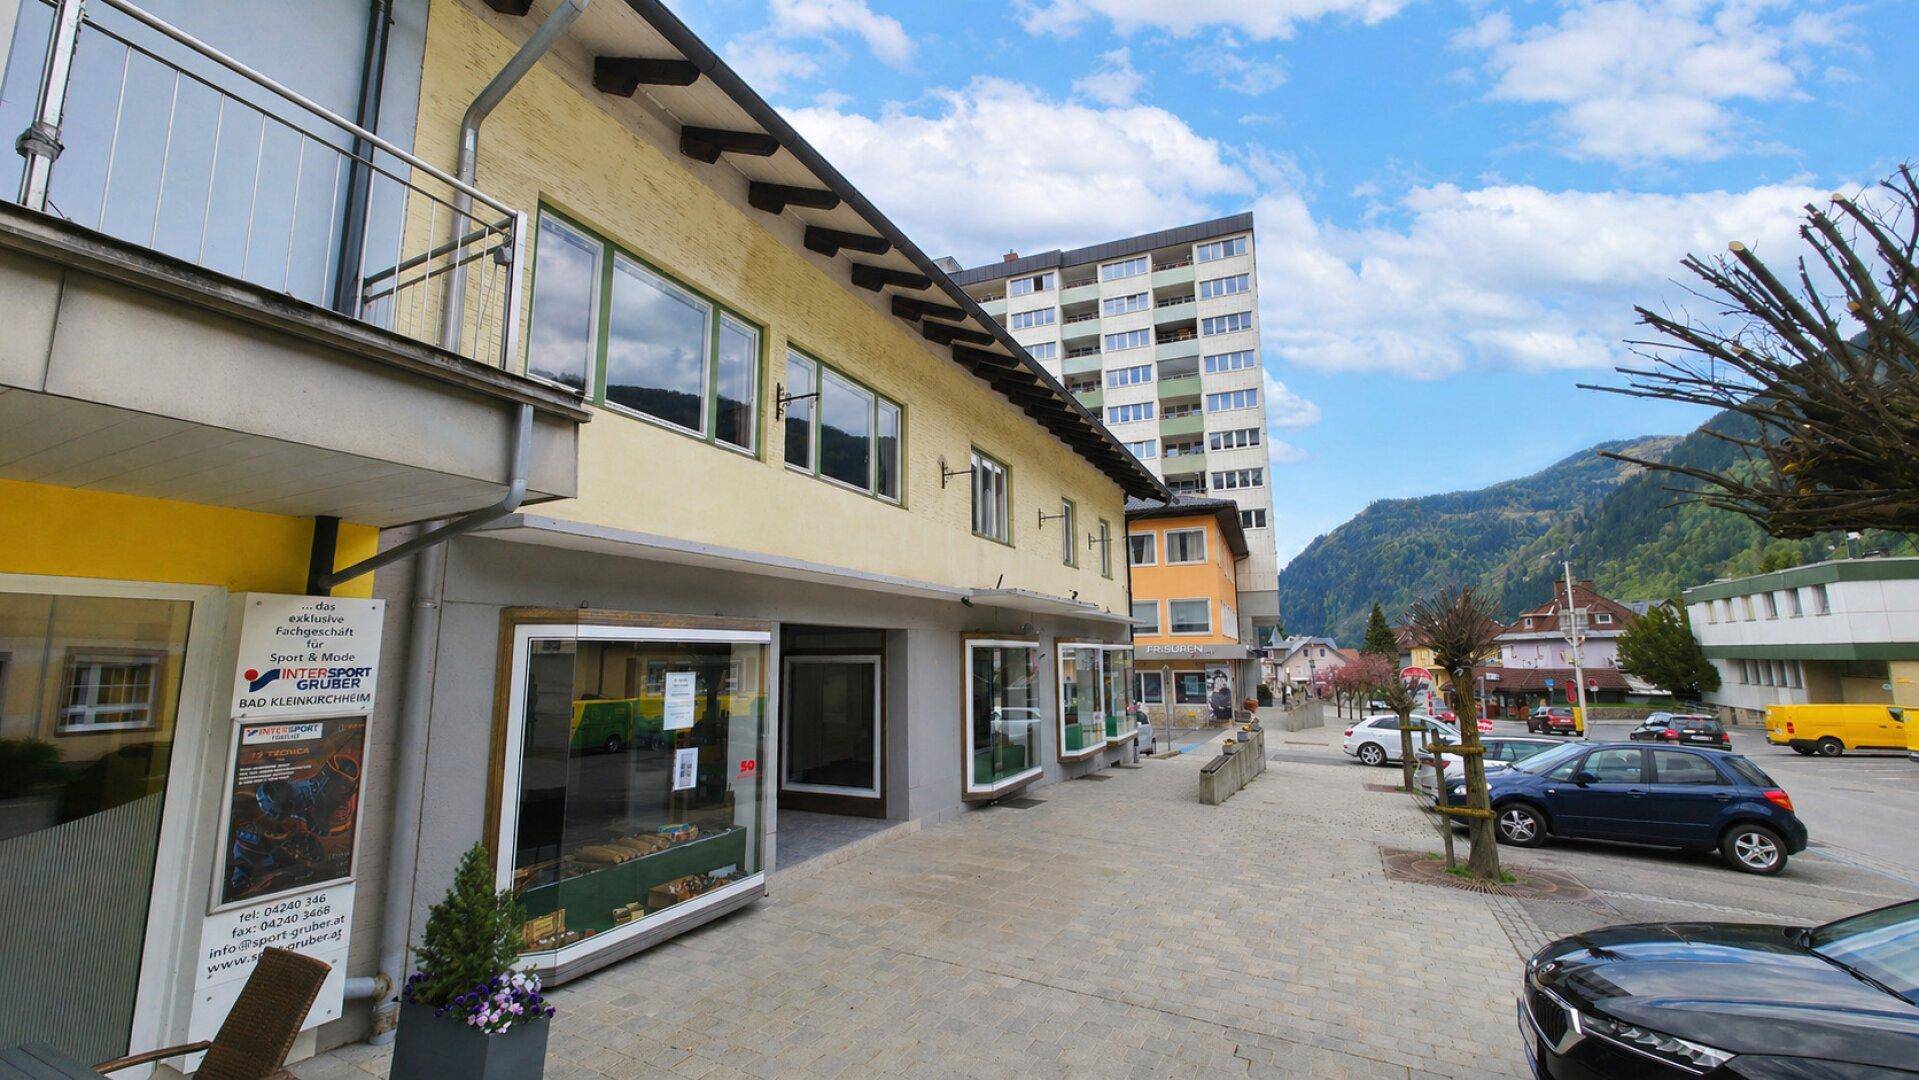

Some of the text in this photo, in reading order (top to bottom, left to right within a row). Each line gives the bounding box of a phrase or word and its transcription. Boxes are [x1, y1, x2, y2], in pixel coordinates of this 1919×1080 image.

[288, 613, 345, 624] exklusive
[276, 626, 354, 638] Fachgeschäft
[306, 639, 325, 649] für
[270, 652, 356, 665] Sport & Mode
[281, 667, 372, 679] INTERSPORT
[296, 678, 361, 691] GRUBER
[239, 692, 371, 709] BAD KLEINKIRCHHEIM
[258, 723, 319, 736] INTERSPORT
[239, 893, 326, 923] tel: 04240 346
[231, 926, 257, 939] fax:
[260, 914, 298, 932] 04240
